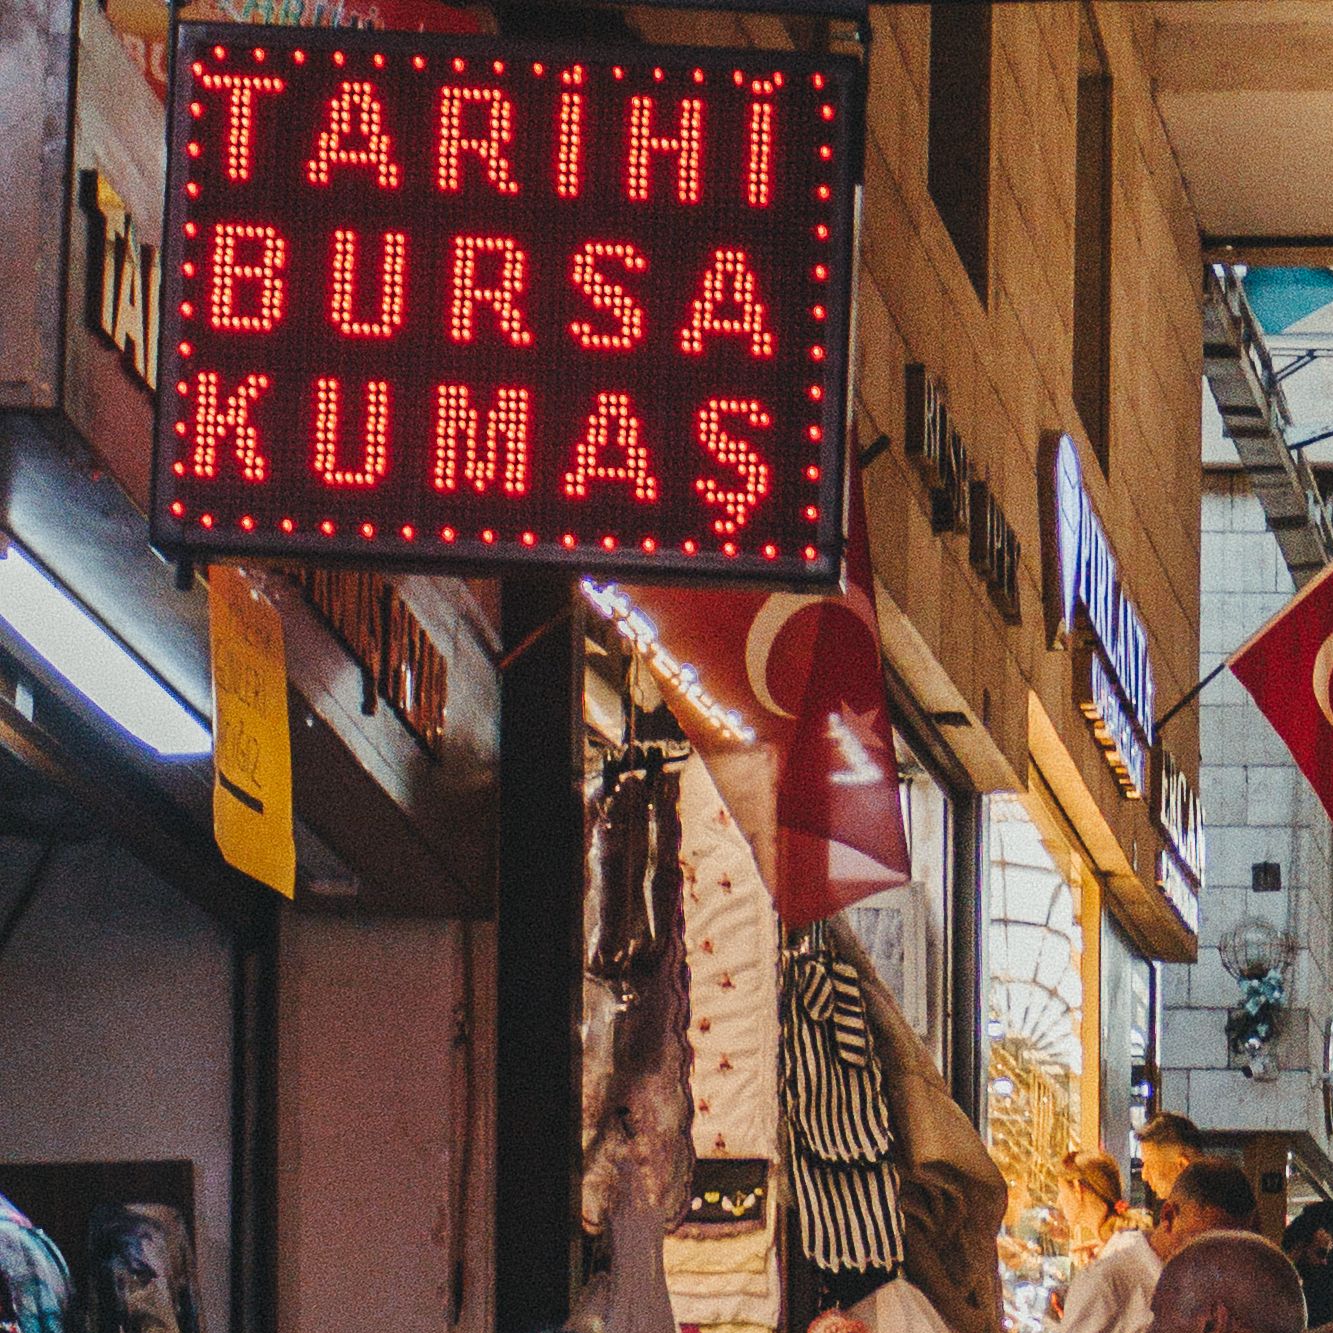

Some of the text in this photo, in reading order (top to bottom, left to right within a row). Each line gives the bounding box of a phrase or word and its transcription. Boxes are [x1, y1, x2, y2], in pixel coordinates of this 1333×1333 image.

[200, 64, 784, 207] TARİHİ
[96, 172, 162, 391] TA
[208, 222, 777, 358] BURSA
[190, 371, 776, 534] KUMAŞ
[1076, 484, 1156, 747] PIRLANTA
